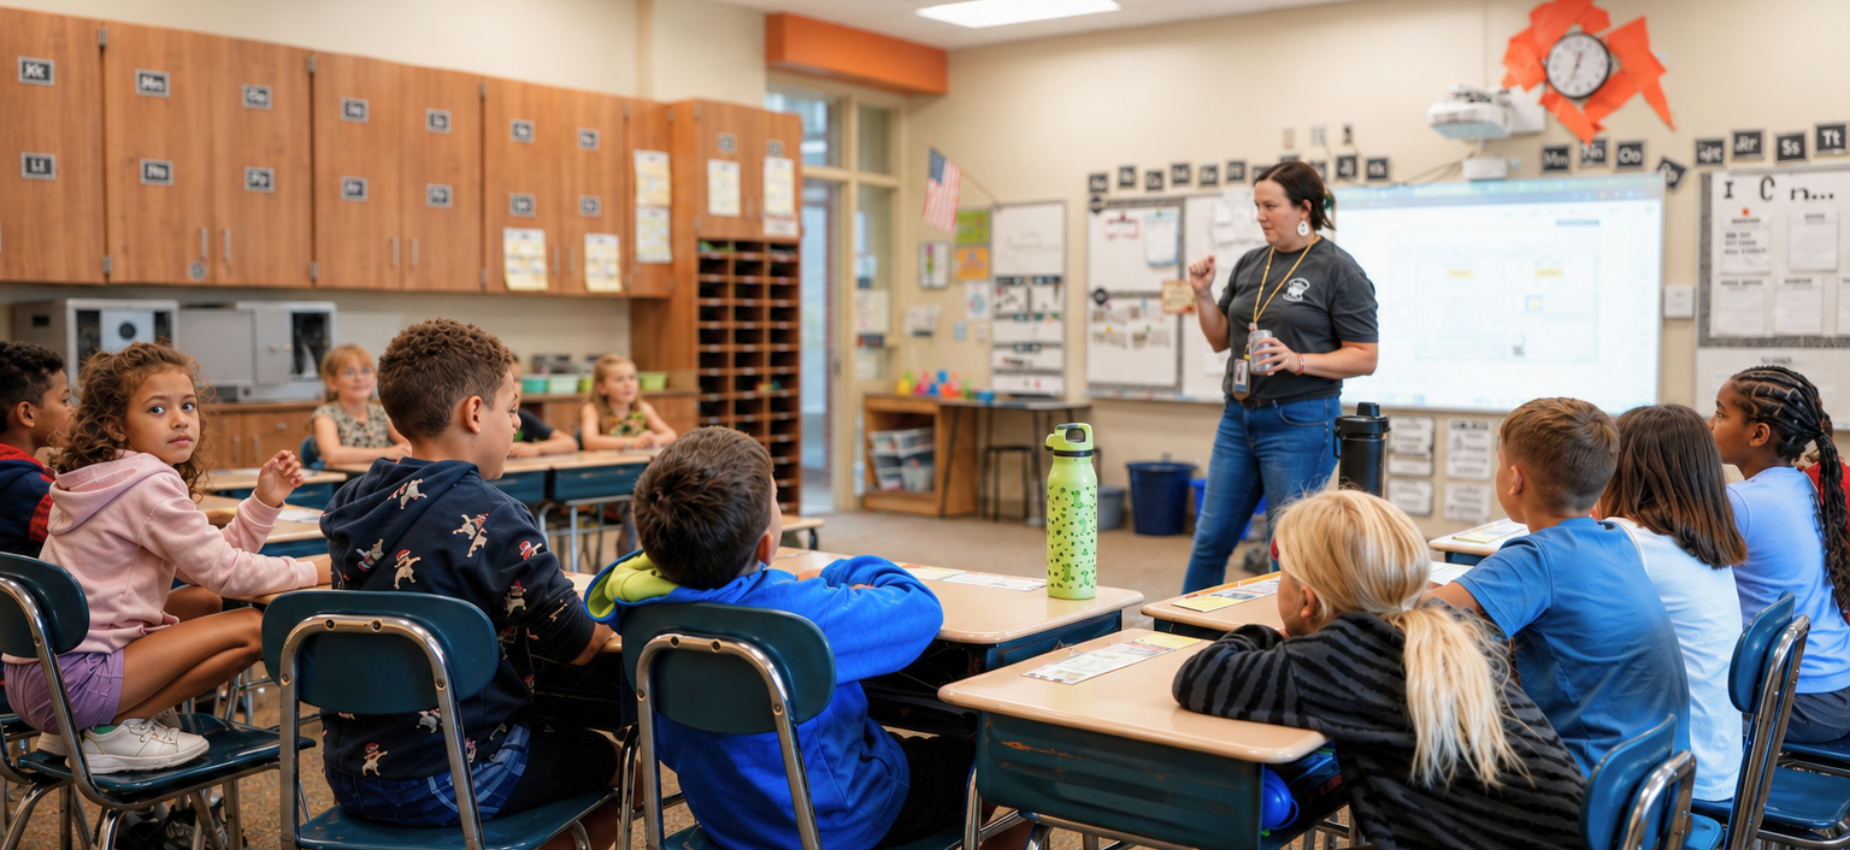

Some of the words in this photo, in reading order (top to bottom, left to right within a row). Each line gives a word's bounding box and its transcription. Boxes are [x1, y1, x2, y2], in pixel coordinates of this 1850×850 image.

[25, 63, 45, 79] Kk
[1822, 129, 1841, 146] Tt
[1618, 147, 1642, 163] Oo
[1781, 138, 1801, 156] Ss
[1724, 181, 1734, 200] I
